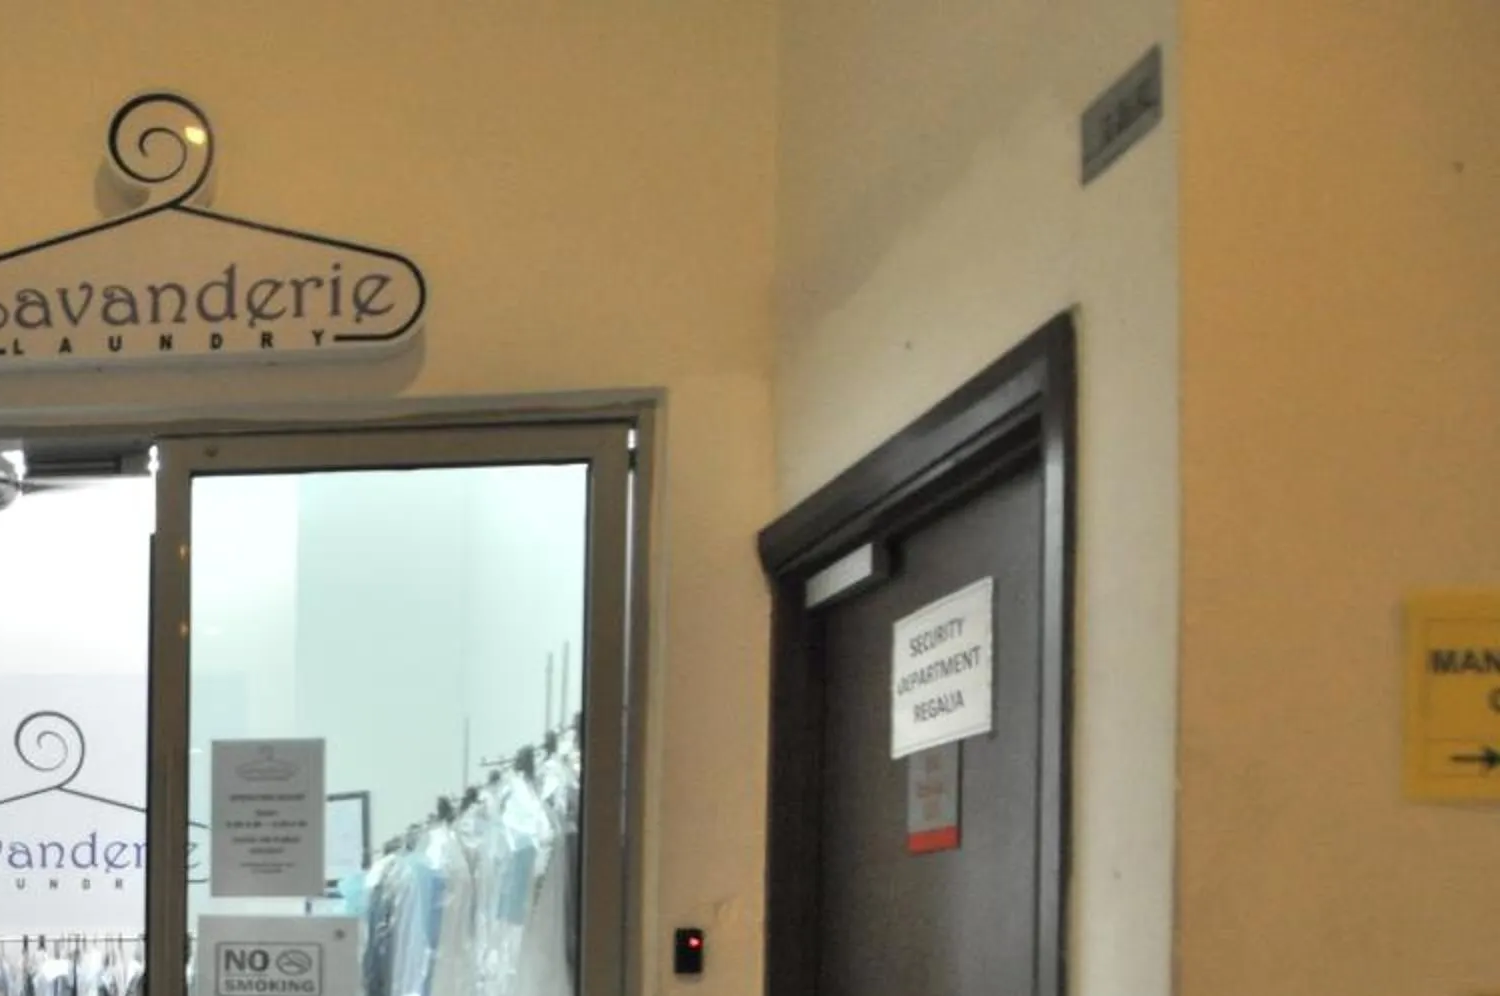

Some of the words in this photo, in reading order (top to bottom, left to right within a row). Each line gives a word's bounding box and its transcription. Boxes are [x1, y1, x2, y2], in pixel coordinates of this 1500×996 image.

[12, 329, 325, 355] LAUNDRY
[909, 617, 965, 657] SECURITY
[898, 645, 981, 695] DEPARTMENT
[913, 690, 965, 722] REGALIA
[225, 949, 270, 972] NO
[224, 979, 316, 993] SMOKING
